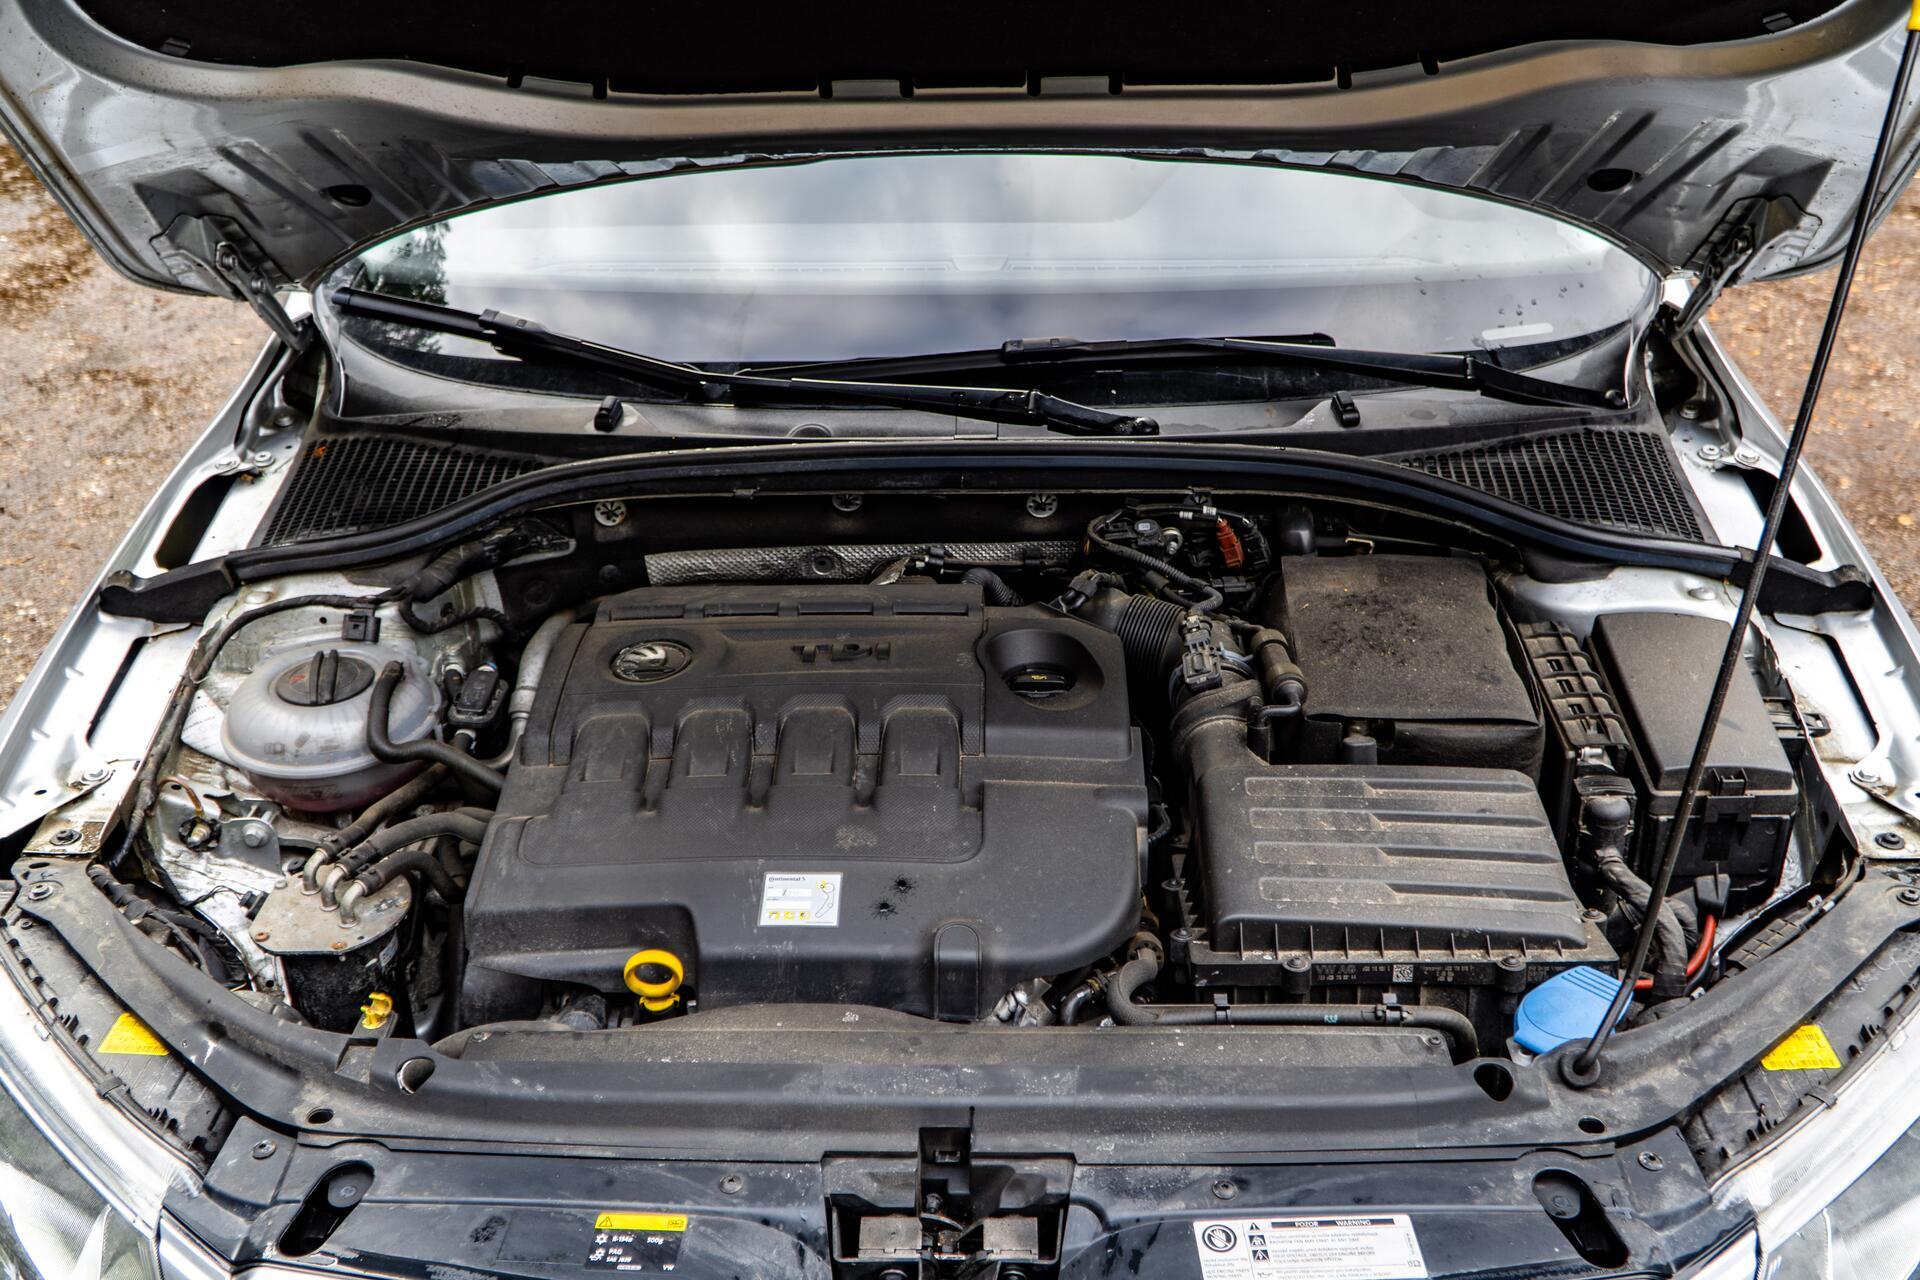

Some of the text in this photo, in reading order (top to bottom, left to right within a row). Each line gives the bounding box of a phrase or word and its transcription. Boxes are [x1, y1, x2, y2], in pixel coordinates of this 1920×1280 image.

[790, 642, 891, 663] TDI
[1294, 1219, 1372, 1228] POZOR WARNING
[608, 1247, 623, 1255] PAG
[662, 1263, 675, 1271] VW
